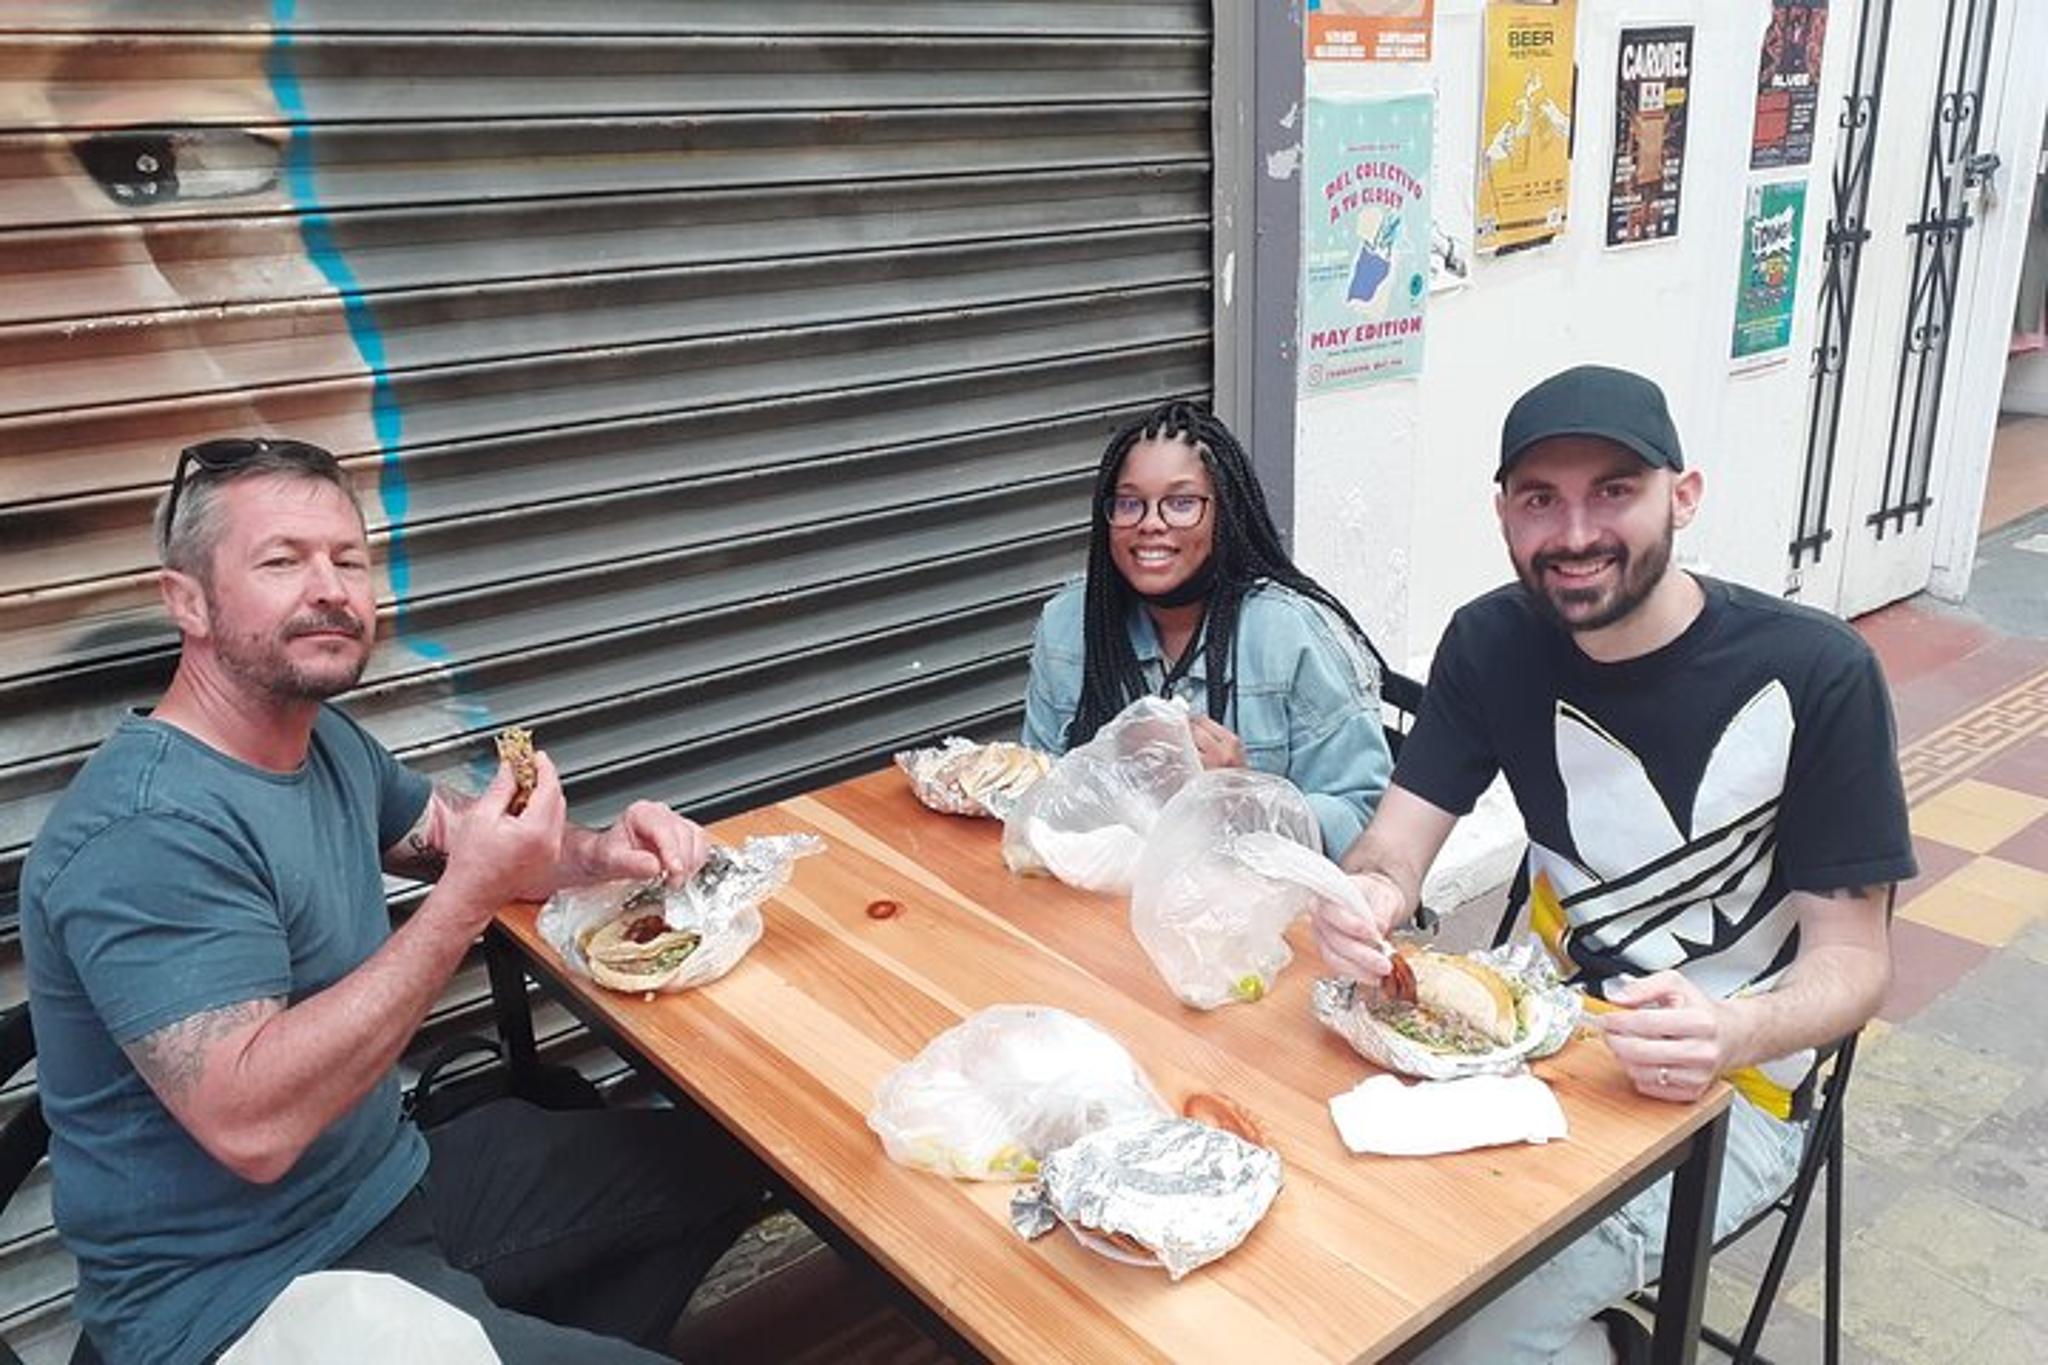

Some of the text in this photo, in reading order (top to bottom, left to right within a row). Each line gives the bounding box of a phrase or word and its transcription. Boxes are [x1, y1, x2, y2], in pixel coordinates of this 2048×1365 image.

[1508, 30, 1554, 48] BEER
[1621, 42, 1688, 80] CARDIEL
[1324, 162, 1422, 200] DEL COLECTIVO
[1330, 204, 1340, 224] A
[1311, 327, 1350, 350] MAY
[1355, 316, 1422, 342] EDITION
